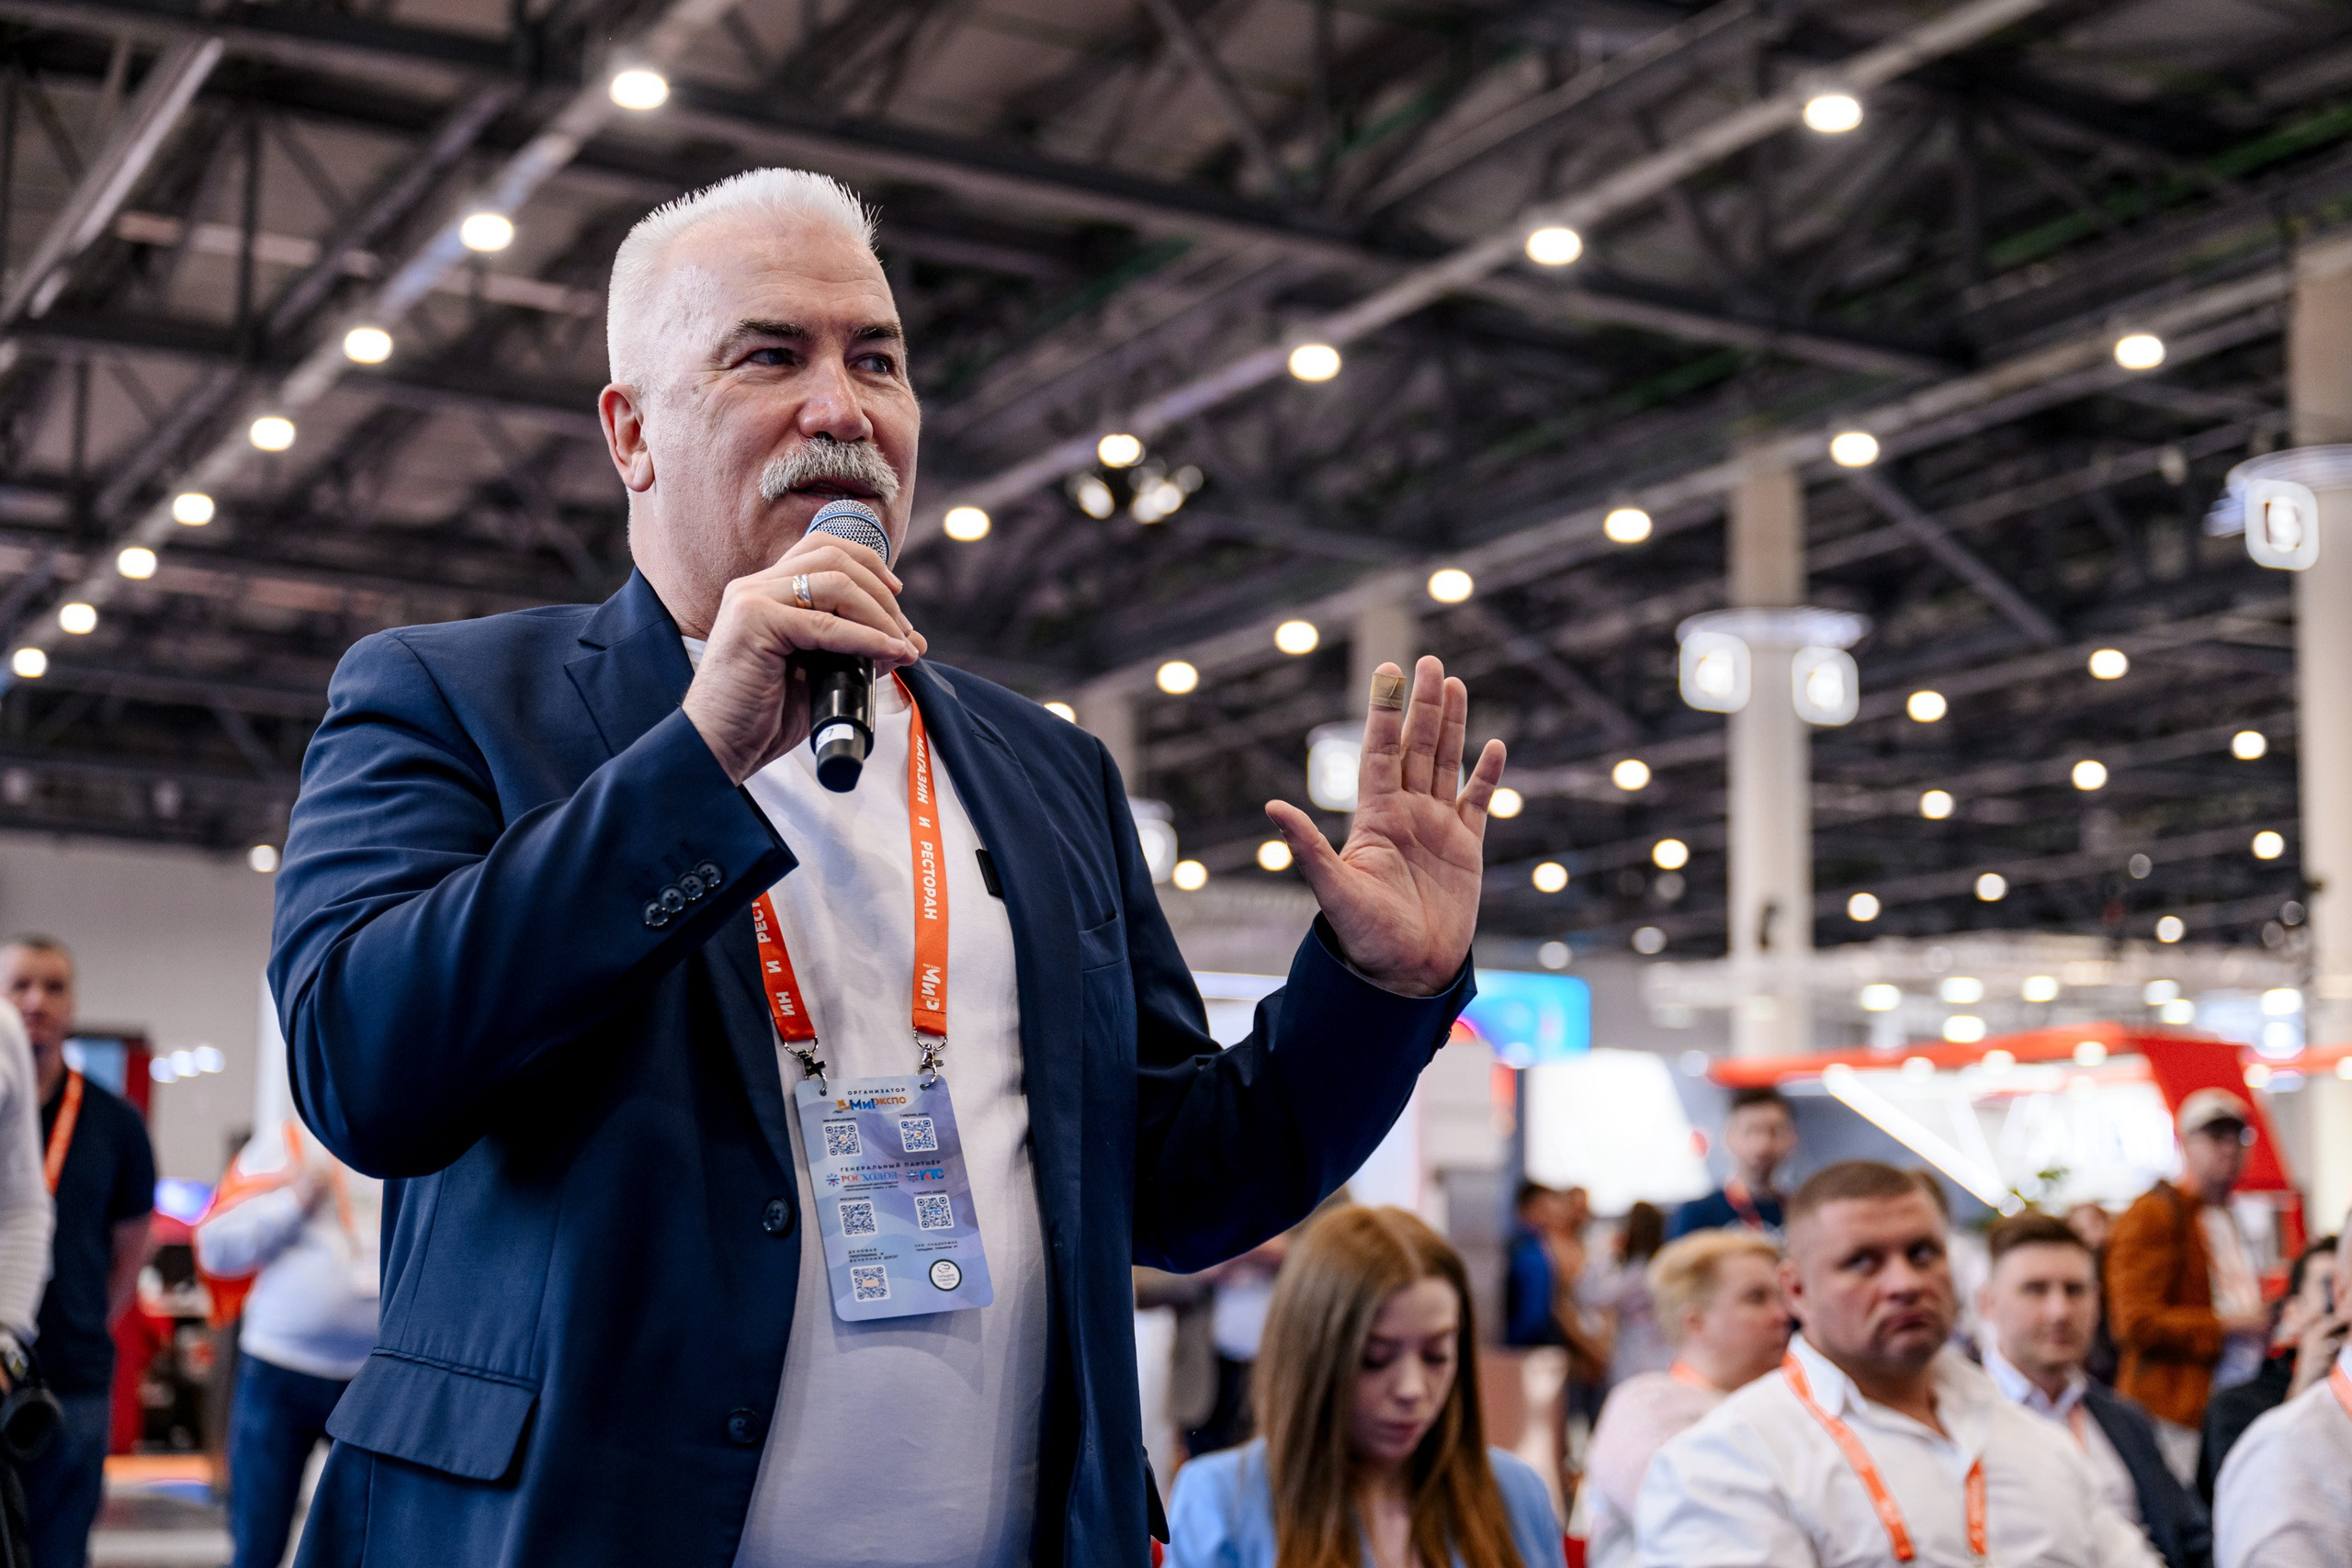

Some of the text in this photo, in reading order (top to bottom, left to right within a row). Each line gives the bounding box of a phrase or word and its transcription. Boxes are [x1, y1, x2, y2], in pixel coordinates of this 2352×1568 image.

[917, 734, 937, 919] МАГАЗИН И РЕСТОРАН
[765, 960, 782, 974] И
[847, 1088, 906, 1096] ОРГАНИЗАТОР
[840, 1161, 900, 1172] ГЕНЕРАЛЬНЫЙ
